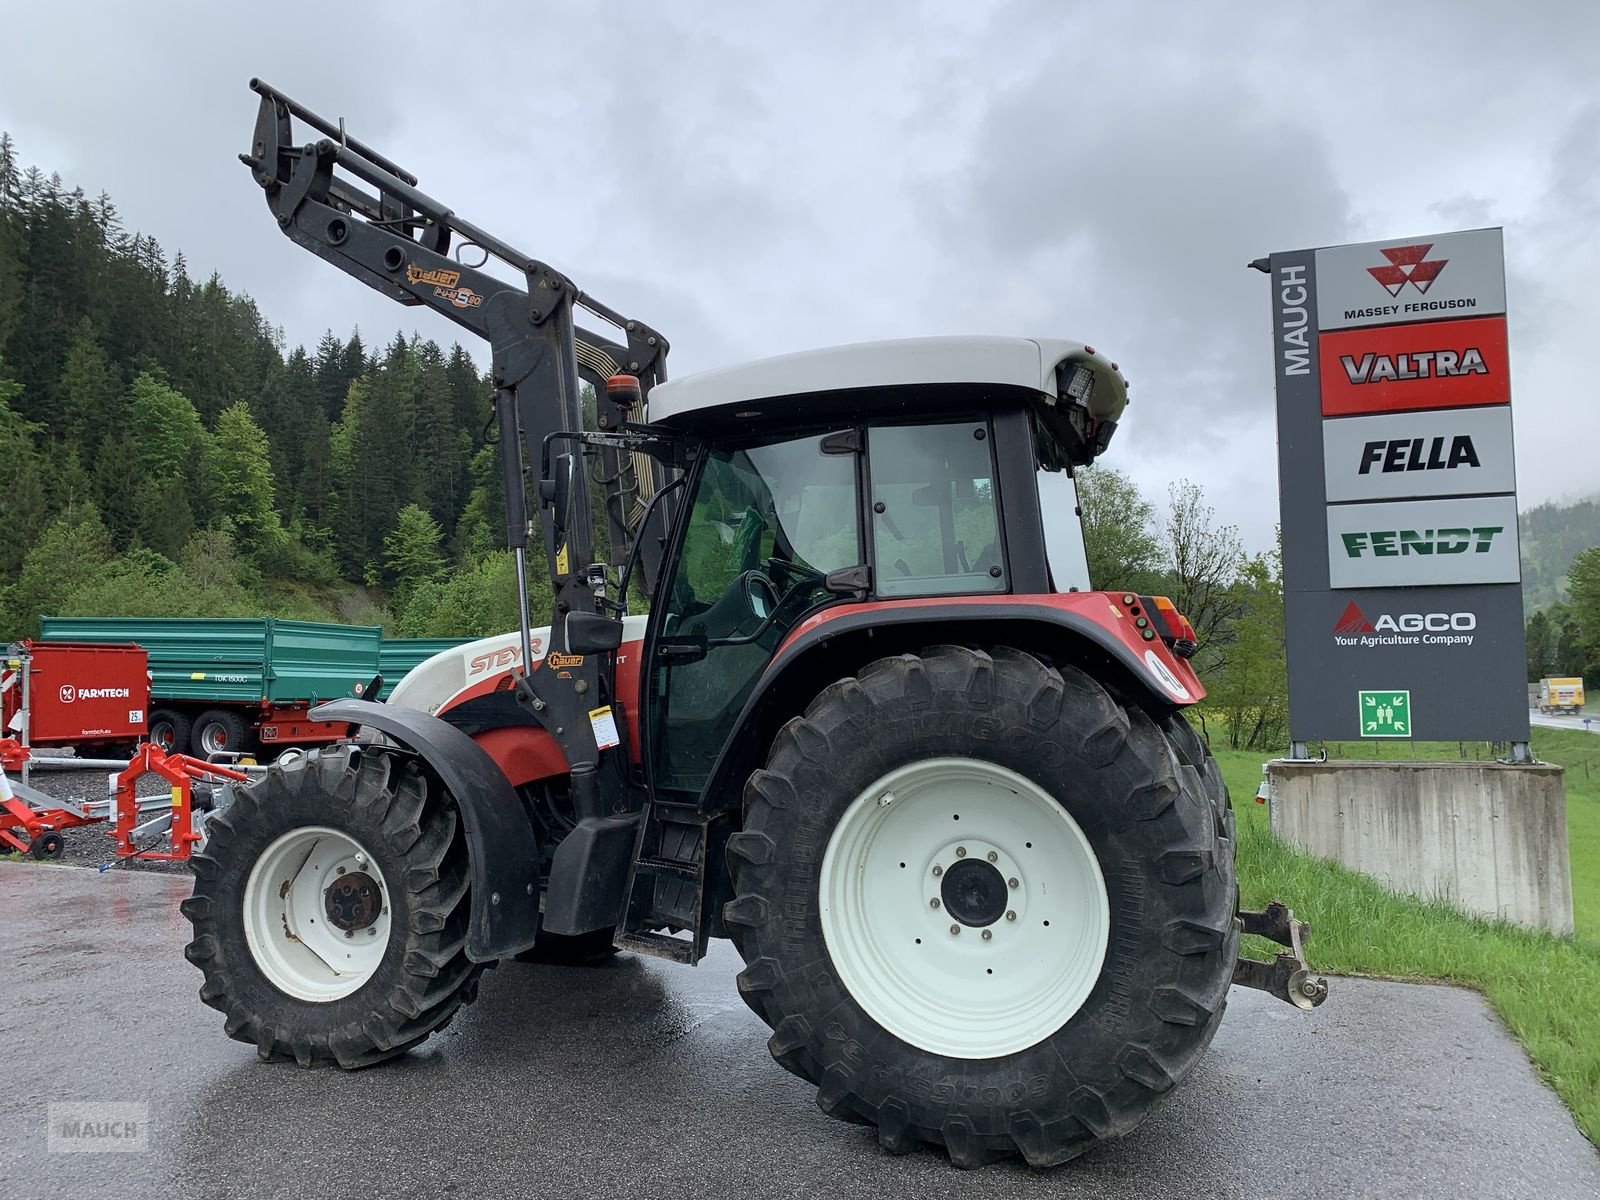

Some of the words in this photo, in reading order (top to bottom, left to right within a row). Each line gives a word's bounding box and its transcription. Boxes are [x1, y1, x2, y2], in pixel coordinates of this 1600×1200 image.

[1281, 265, 1310, 376] MAUCH
[1344, 305, 1400, 320] MASSEY
[1404, 298, 1476, 313] FERGUSON
[1340, 348, 1489, 385] VALTRA
[1358, 435, 1481, 475] FELLA
[1341, 527, 1504, 558] FENDT
[1374, 612, 1476, 632] AGCO
[1334, 636, 1358, 647] Your
[1360, 634, 1420, 648] Agriculture
[1422, 633, 1474, 647] Company
[469, 638, 542, 676] STEYR
[552, 656, 581, 666] hauer
[78, 688, 129, 700] FARMTECH
